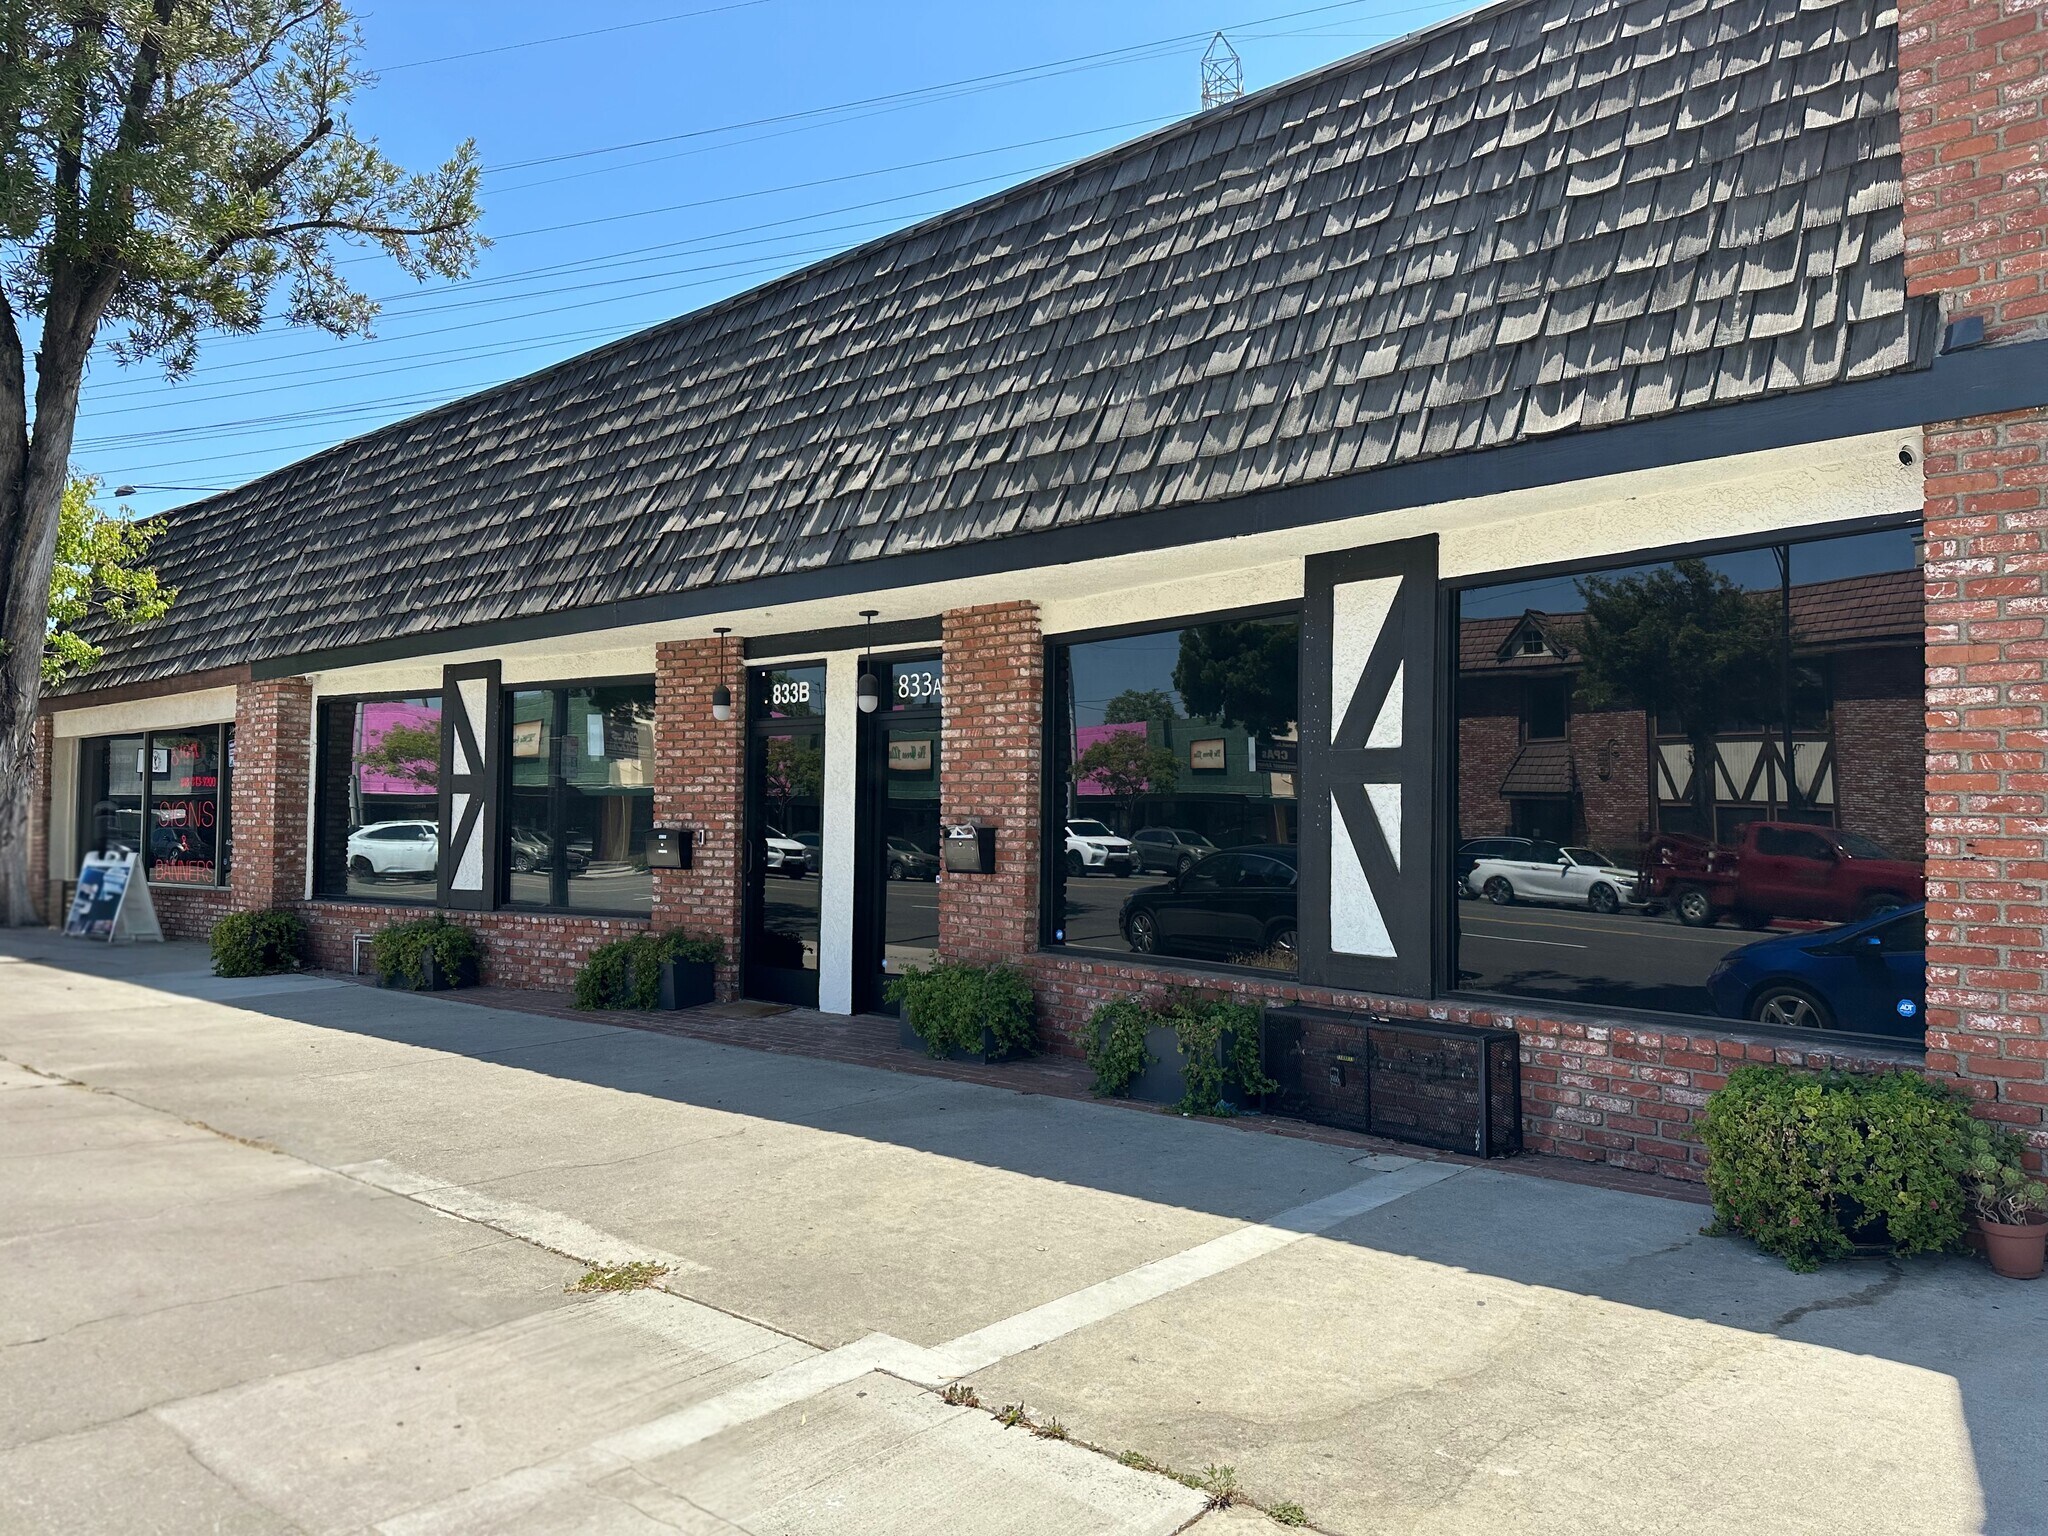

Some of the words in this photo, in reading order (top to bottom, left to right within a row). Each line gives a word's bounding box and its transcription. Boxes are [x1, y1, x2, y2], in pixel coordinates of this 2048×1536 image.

[773, 681, 810, 704] 833B
[899, 672, 943, 698] 833A
[159, 801, 215, 828] SIGNS
[181, 835, 190, 851] &
[156, 859, 214, 882] BANNERS
